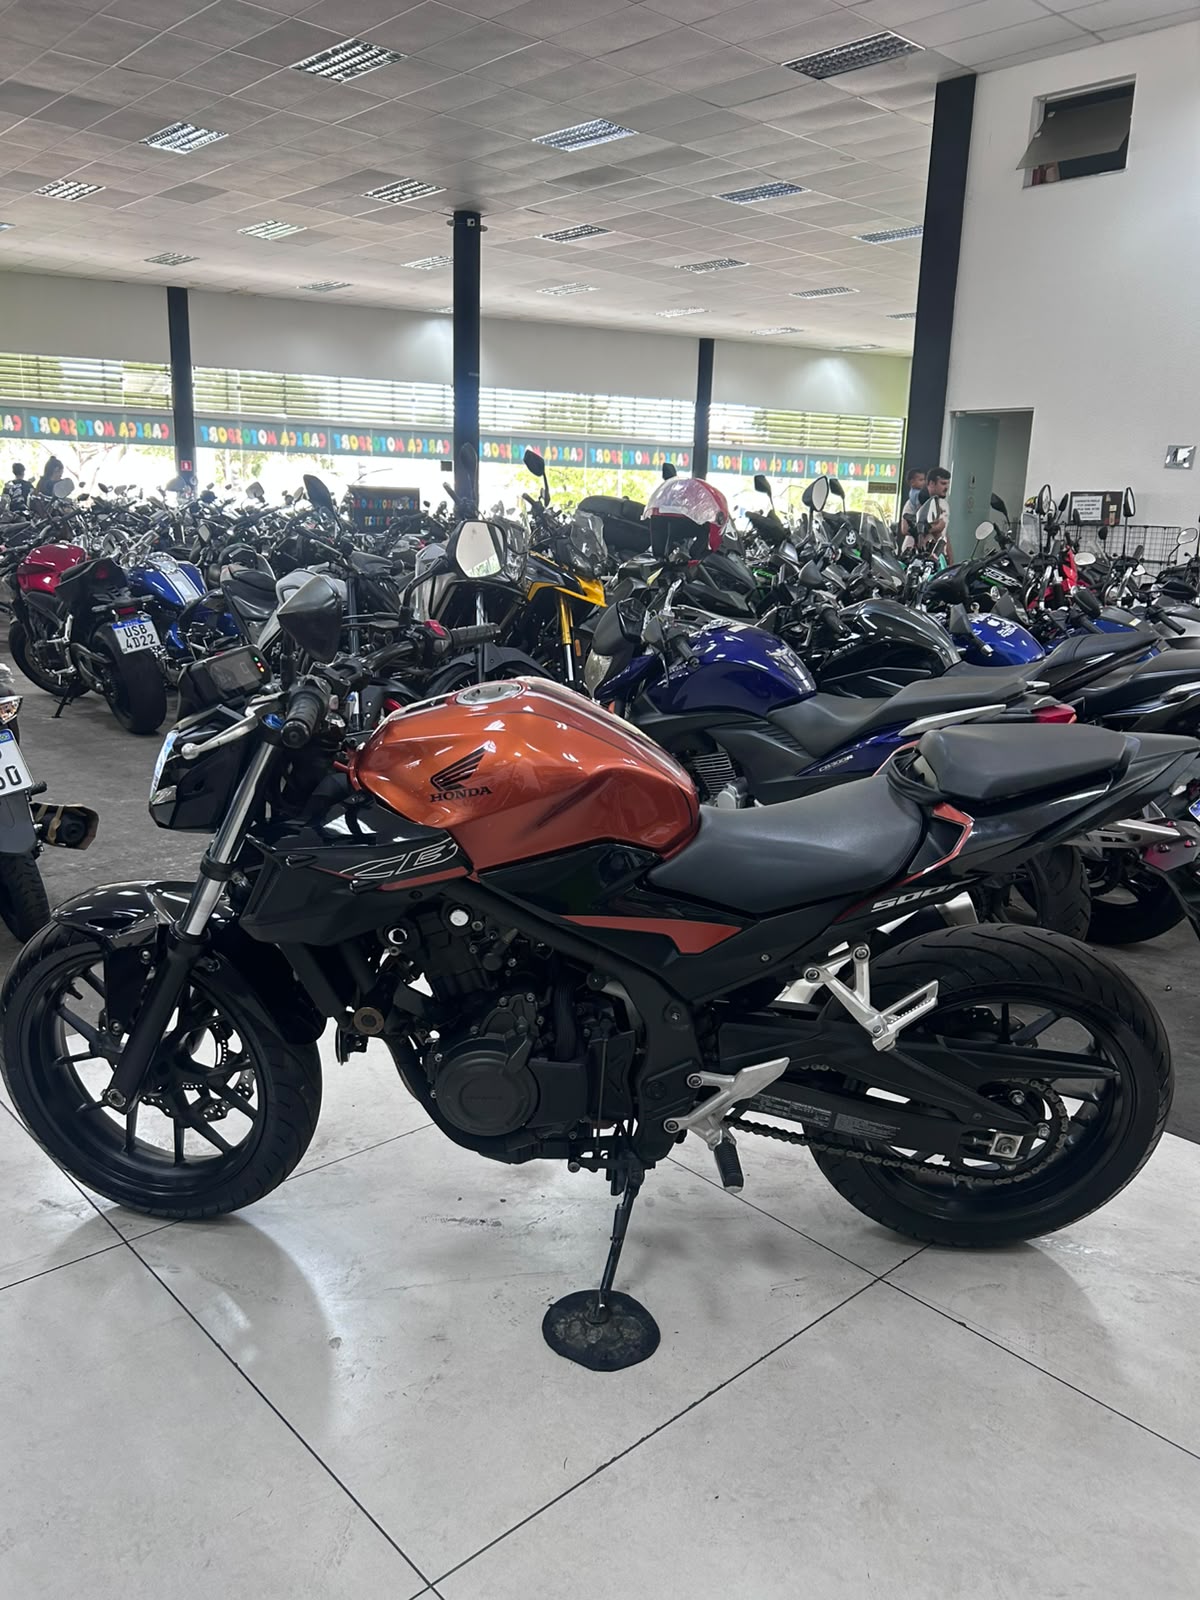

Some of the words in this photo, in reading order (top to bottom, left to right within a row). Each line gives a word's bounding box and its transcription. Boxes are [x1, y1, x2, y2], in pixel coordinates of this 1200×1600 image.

[123, 624, 147, 637] USB
[126, 633, 155, 649] 4D22
[430, 786, 493, 802] HONDA
[339, 837, 459, 879] CB
